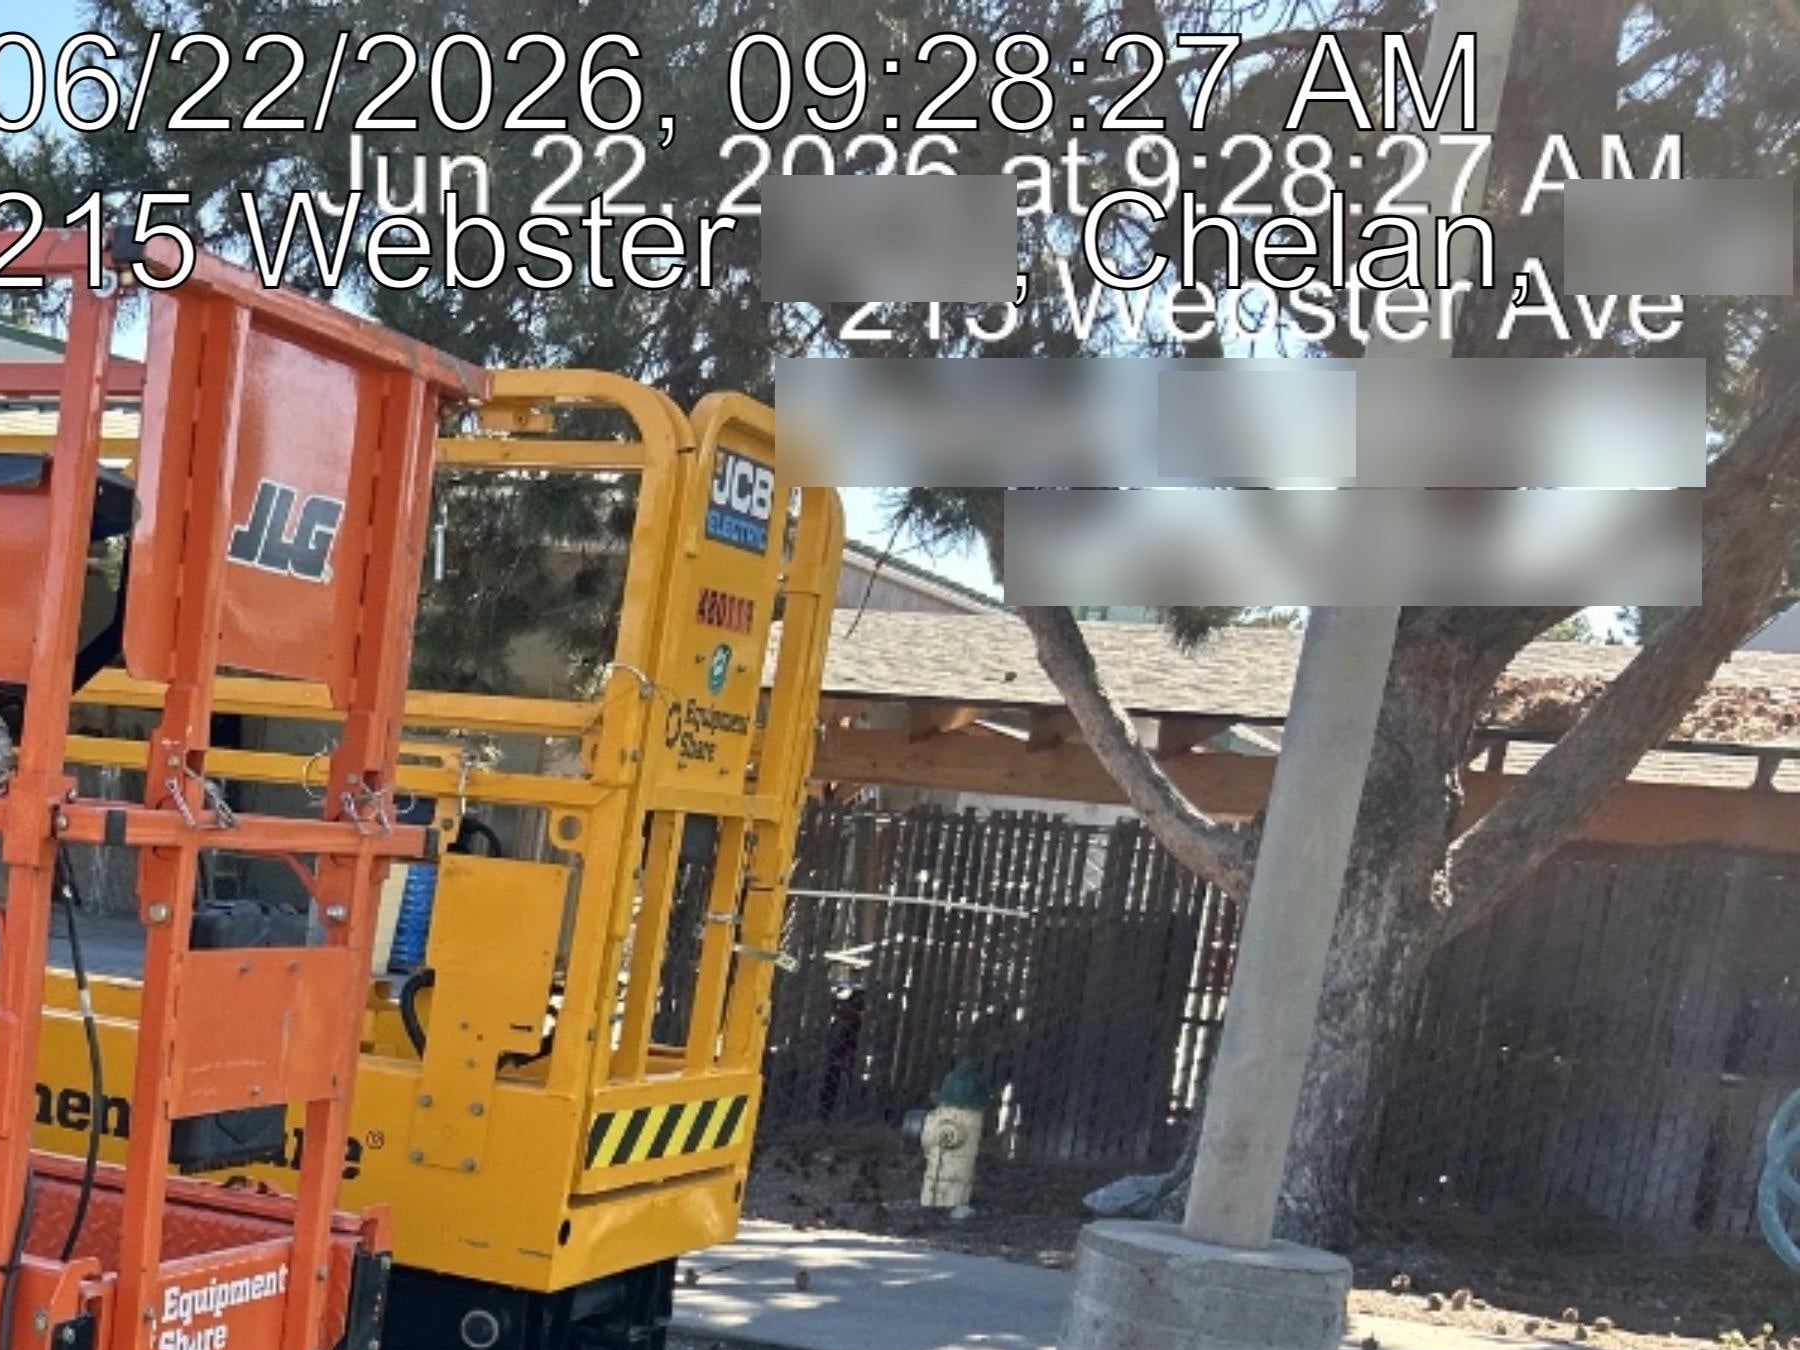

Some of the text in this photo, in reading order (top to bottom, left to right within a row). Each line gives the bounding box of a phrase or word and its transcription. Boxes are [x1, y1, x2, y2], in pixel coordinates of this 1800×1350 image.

[713, 455, 775, 521] JCB
[226, 478, 345, 583] JLG
[707, 509, 768, 551] ELECTRIC
[684, 697, 750, 737] Equipment
[679, 730, 716, 763] Share
[162, 1262, 289, 1326] Equipment
